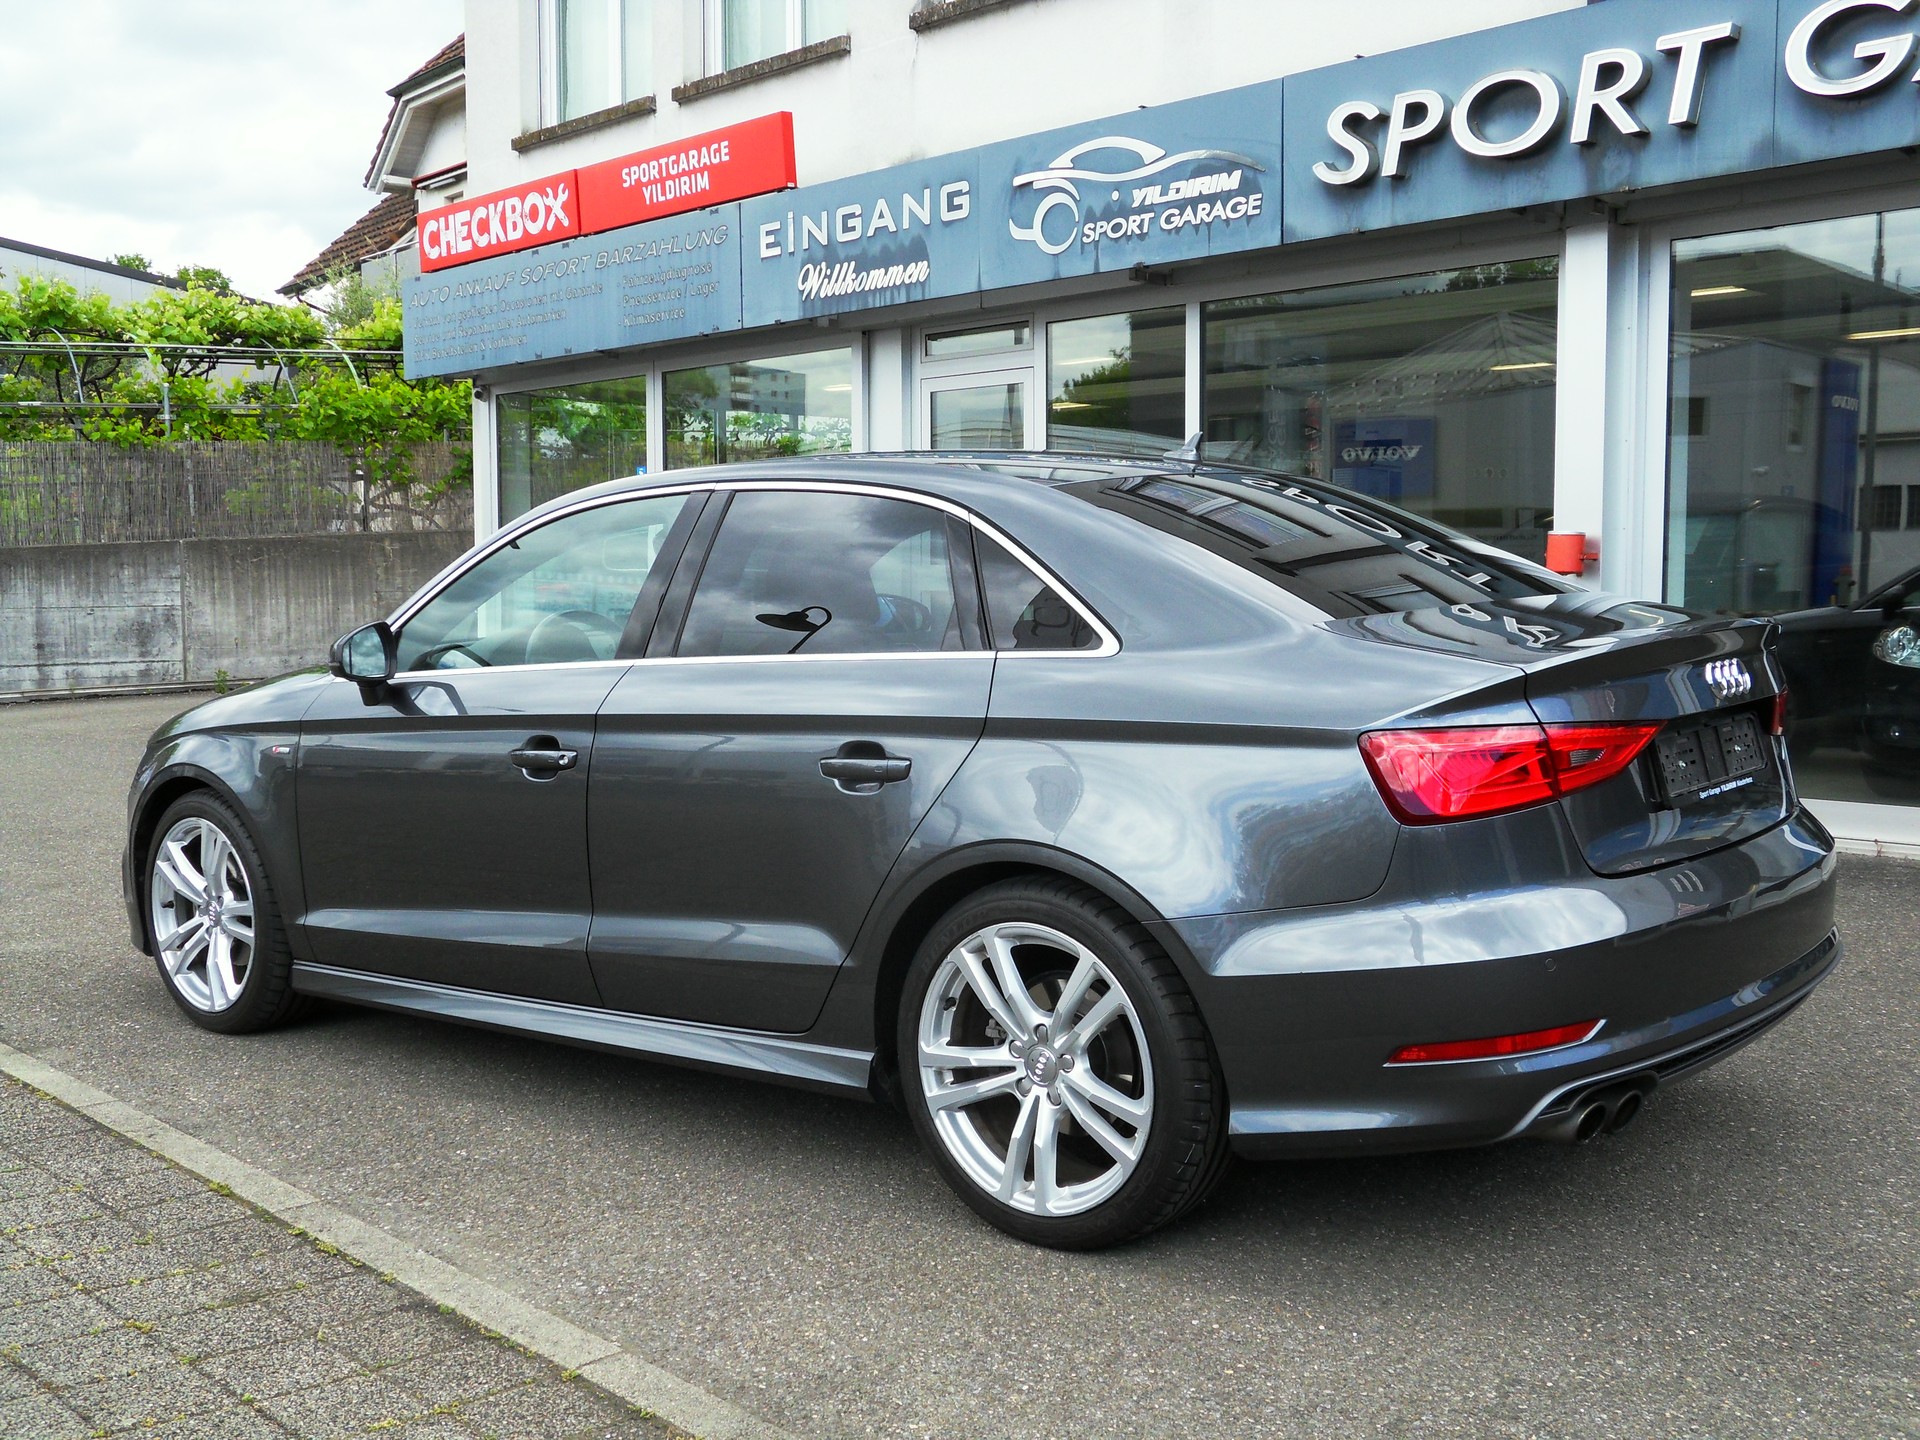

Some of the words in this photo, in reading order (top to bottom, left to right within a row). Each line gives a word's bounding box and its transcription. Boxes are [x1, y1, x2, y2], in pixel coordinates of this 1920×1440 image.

[1312, 21, 1742, 187] SPORT
[1784, 0, 1920, 96] G
[621, 140, 730, 188] SPORTGARAGE
[642, 170, 710, 205] YILDIRIM
[1131, 169, 1243, 208] YILDIRIM
[422, 182, 569, 260] CHECKBOX
[1082, 212, 1155, 244] SPORT
[1159, 193, 1263, 231] GARAGE
[408, 285, 450, 310] AUTO
[453, 271, 517, 301] ANKAUF
[519, 254, 592, 286] SOFORT
[595, 224, 729, 270] BARZAHLUNG
[797, 259, 930, 301] Willkommen
